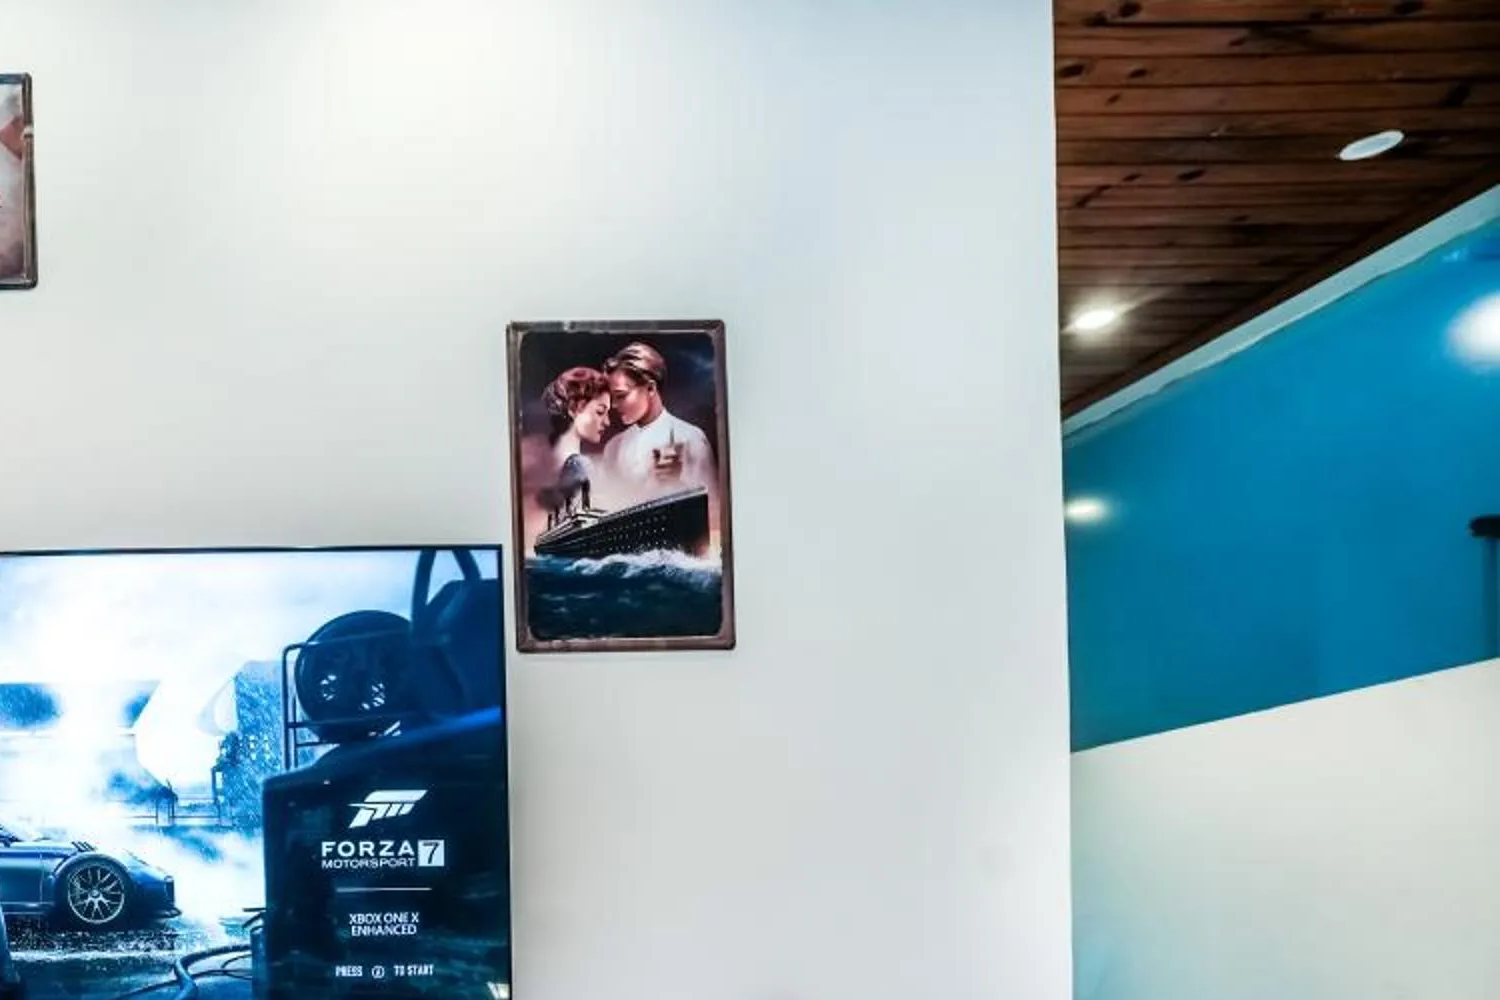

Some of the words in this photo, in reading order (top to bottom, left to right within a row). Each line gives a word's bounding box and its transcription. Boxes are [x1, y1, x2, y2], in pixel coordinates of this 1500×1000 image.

[321, 840, 415, 857] FORZA
[422, 841, 441, 865] 7
[321, 858, 416, 869] MOTORSPORT
[348, 913, 382, 925] XBOX
[383, 912, 409, 924] ONE
[411, 911, 420, 923] X
[351, 923, 417, 937] ENHANCED
[335, 965, 363, 977] PRESS
[394, 964, 405, 976] TO
[407, 963, 434, 976] START
